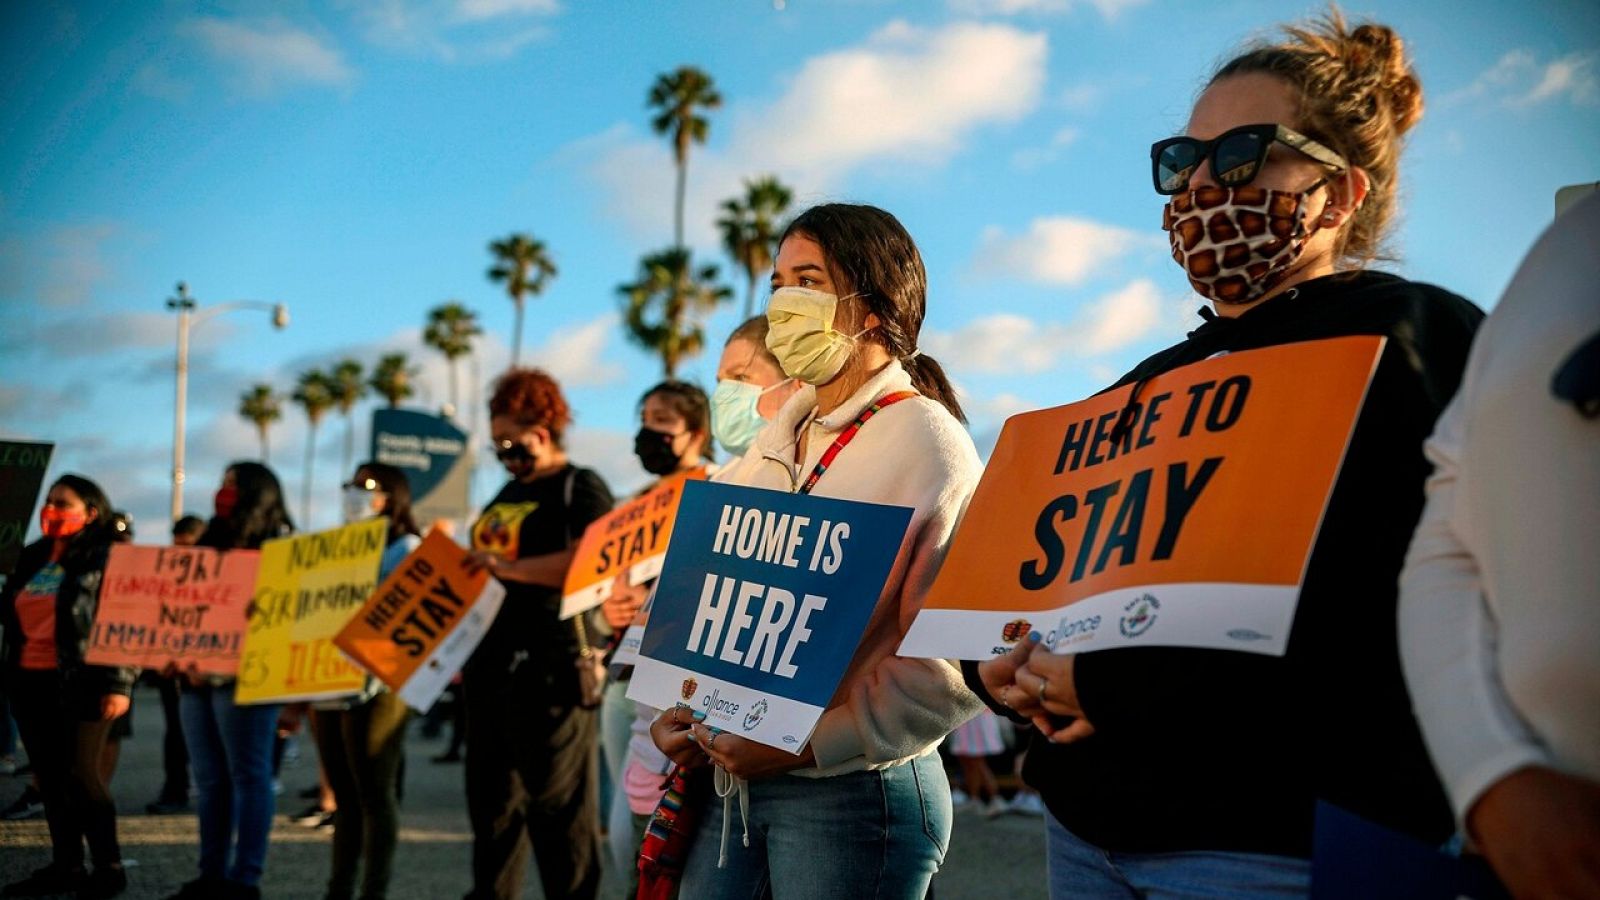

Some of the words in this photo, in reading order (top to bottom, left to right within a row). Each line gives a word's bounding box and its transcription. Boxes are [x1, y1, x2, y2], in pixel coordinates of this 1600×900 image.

[1053, 392, 1171, 475] HERE
[1178, 375, 1252, 438] TO
[596, 516, 667, 575] STAY
[606, 501, 647, 534] HERE
[653, 488, 675, 511] TO
[712, 504, 810, 568] HOME
[808, 520, 851, 575] IS
[1019, 456, 1225, 590] STAY
[159, 603, 210, 630] NOT
[364, 583, 412, 631] HERE
[404, 556, 435, 584] TO
[391, 576, 465, 657] STAY
[686, 573, 828, 679] HERE
[703, 689, 739, 716] alliance
